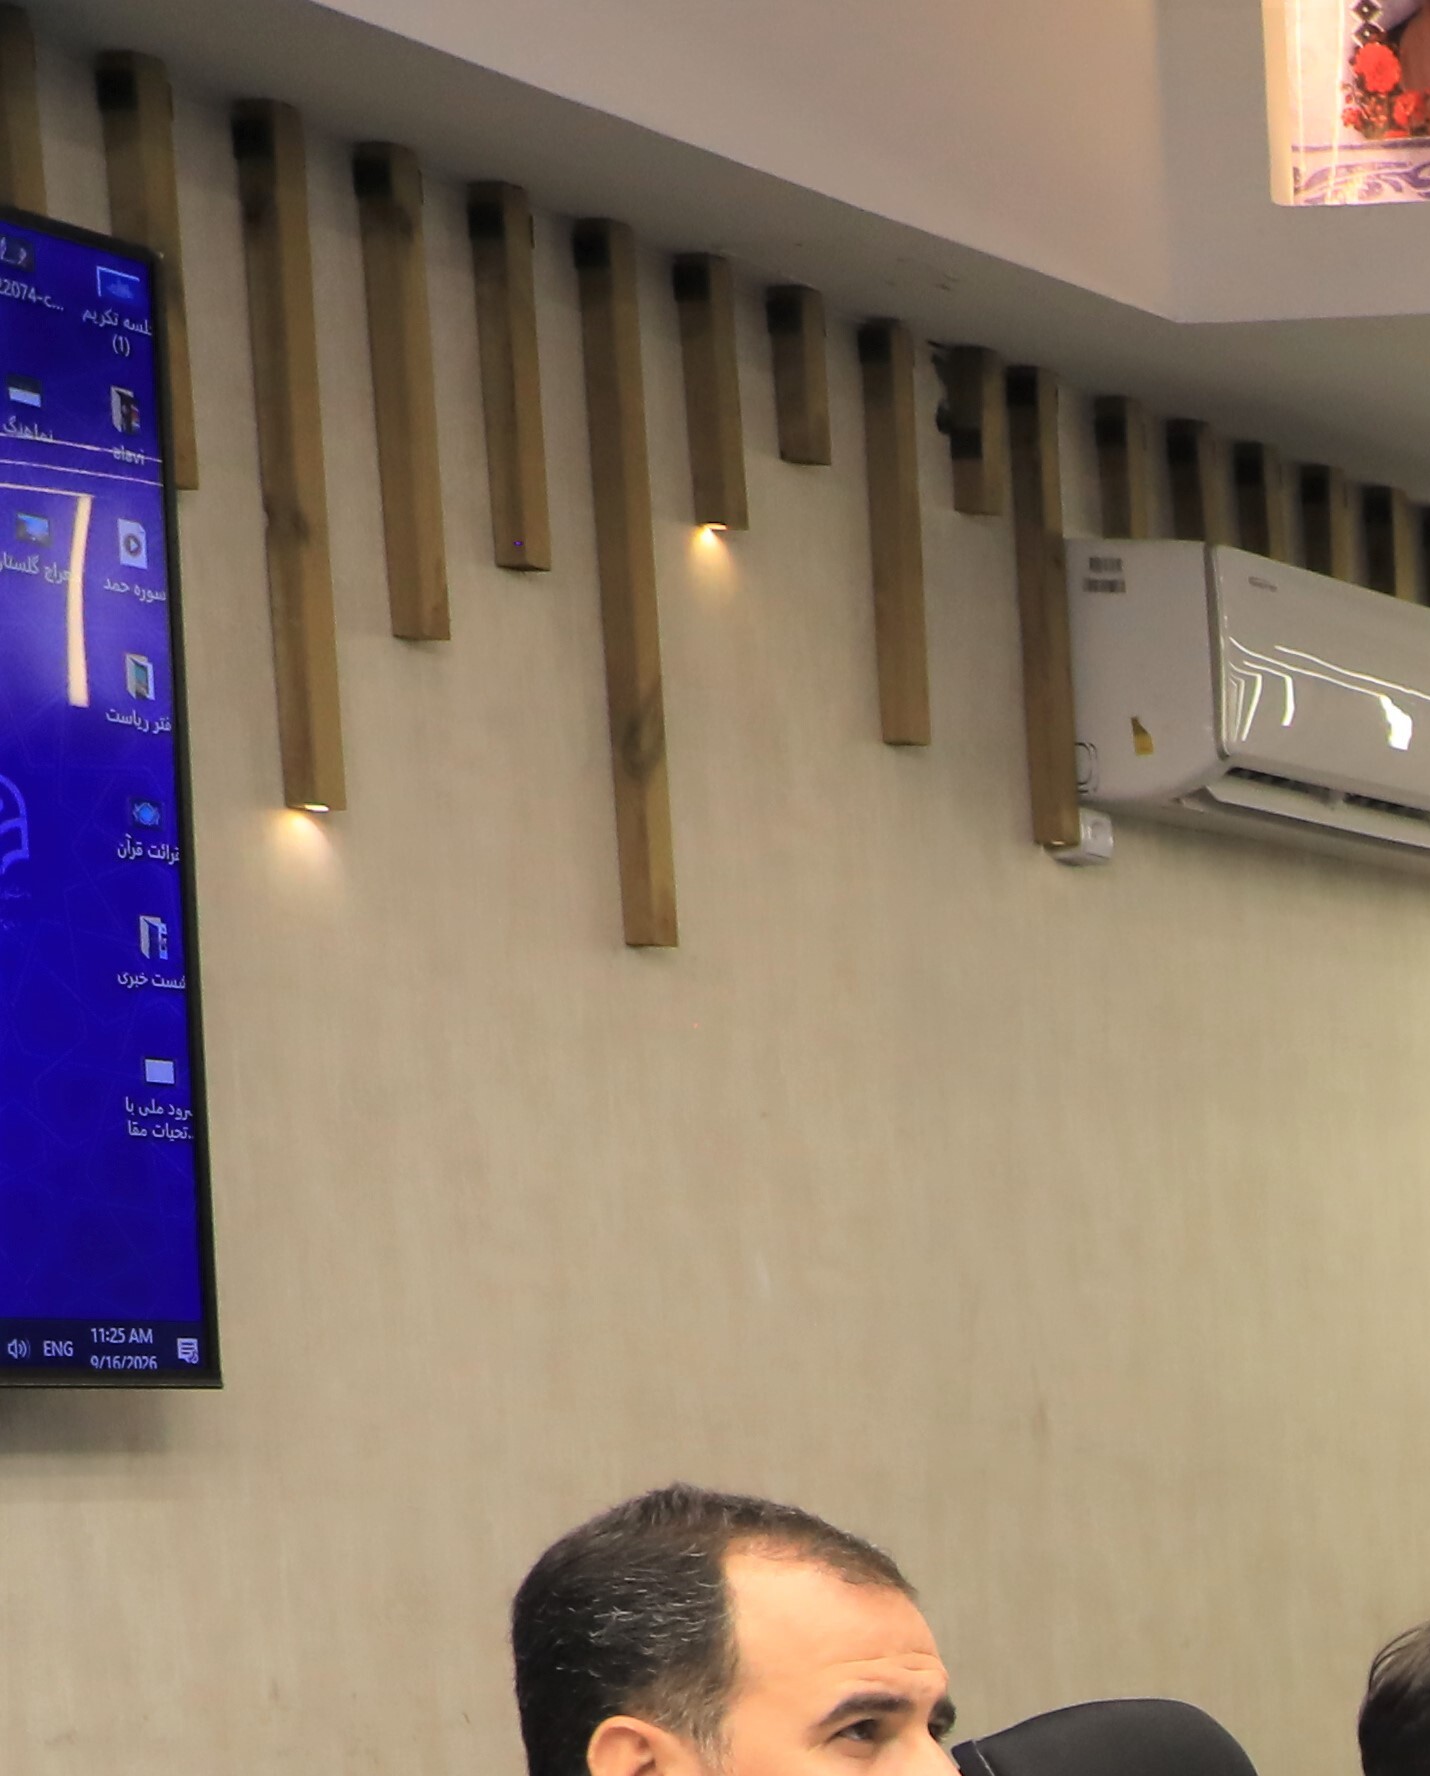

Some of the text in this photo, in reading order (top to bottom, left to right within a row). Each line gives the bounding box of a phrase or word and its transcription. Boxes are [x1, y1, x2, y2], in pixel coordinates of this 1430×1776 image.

[82, 308, 119, 328] تکریم
[112, 334, 131, 357] (1)
[103, 577, 167, 604] سوره حمد
[105, 708, 150, 732] ریاست
[117, 832, 143, 860] قرآن
[117, 972, 149, 990] خبری
[125, 1094, 134, 1114] با
[138, 1098, 164, 1118] ملی
[128, 1119, 148, 1140] مقا
[91, 1327, 154, 1345] 11:25 AM
[43, 1340, 74, 1357] ENG
